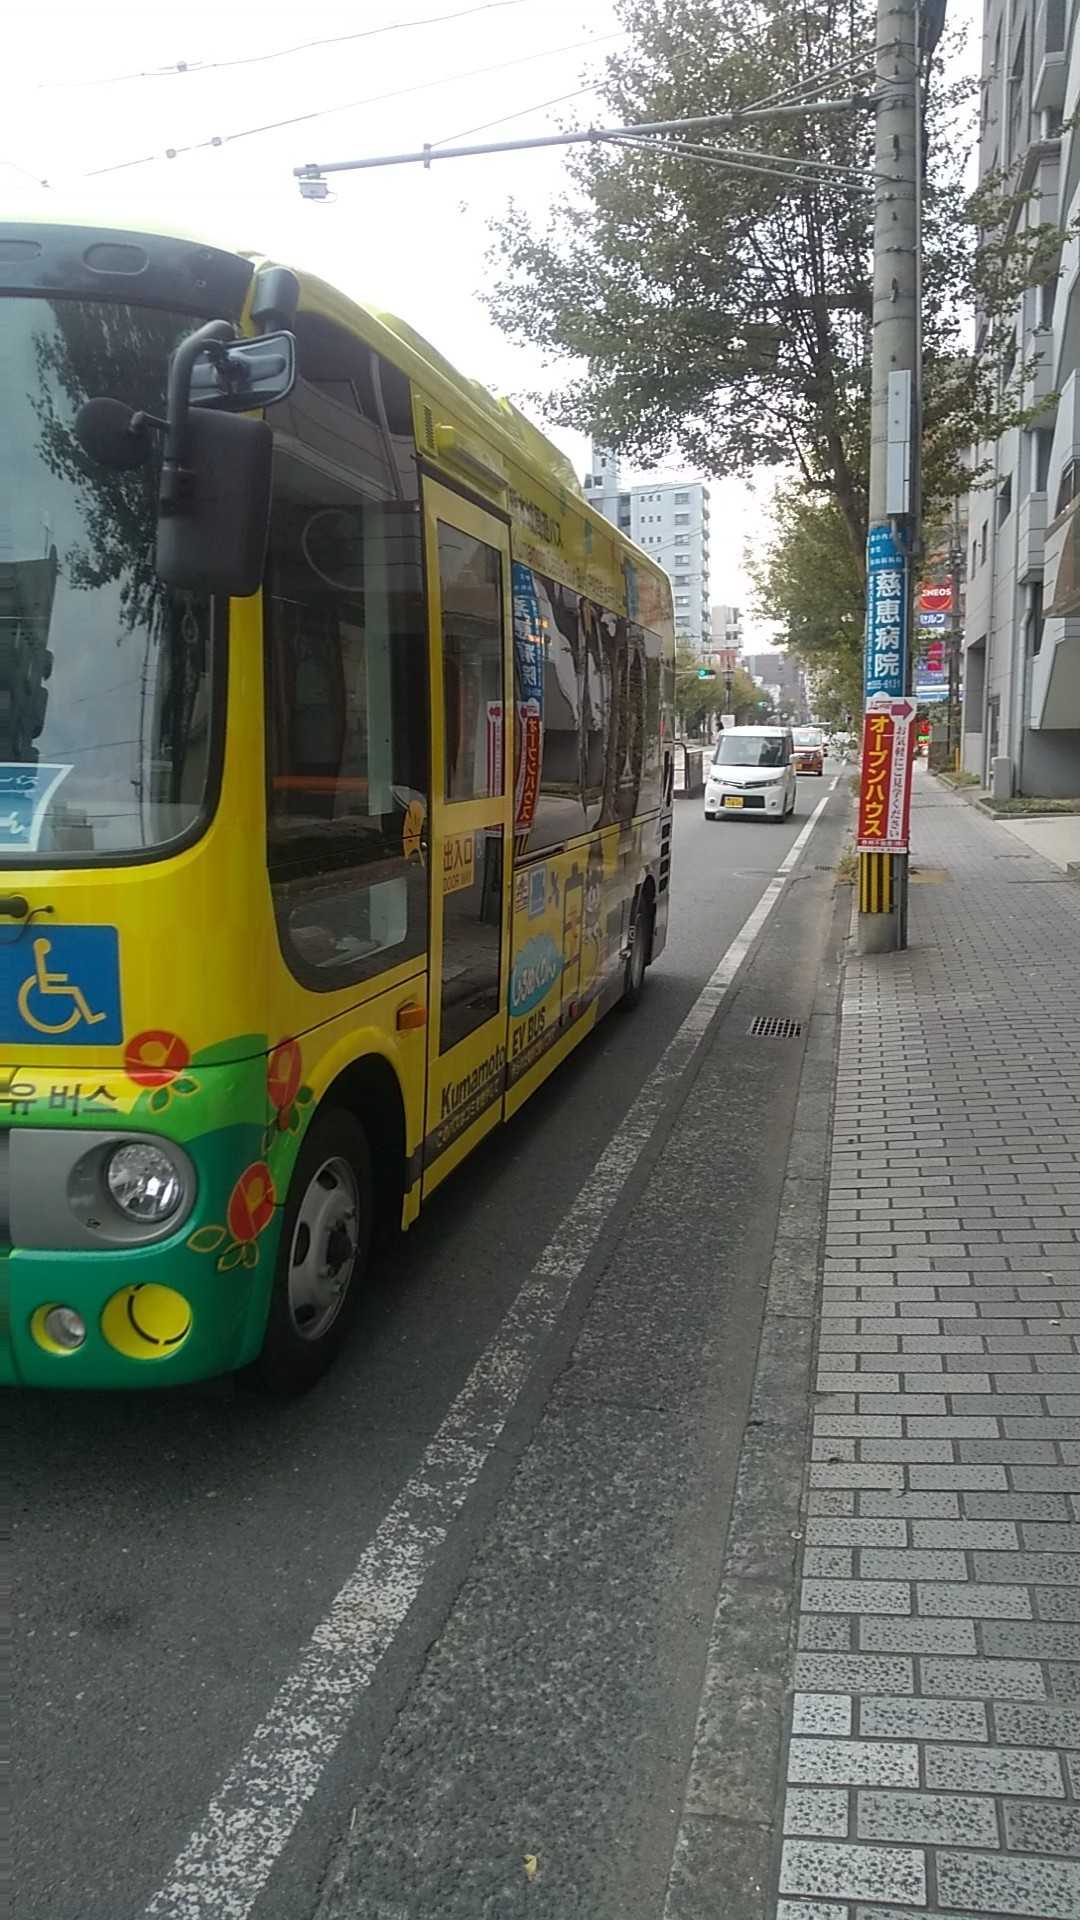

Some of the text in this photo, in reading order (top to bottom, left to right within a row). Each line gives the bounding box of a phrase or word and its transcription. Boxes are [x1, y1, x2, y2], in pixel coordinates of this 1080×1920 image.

[874, 572, 902, 678] 慈恵病院
[863, 715, 890, 837] オープンハウス
[443, 837, 473, 872] 出入口
[441, 1045, 506, 1120] Kumamoto
[512, 1022, 527, 1057] EV
[528, 1006, 546, 1042] BUS
